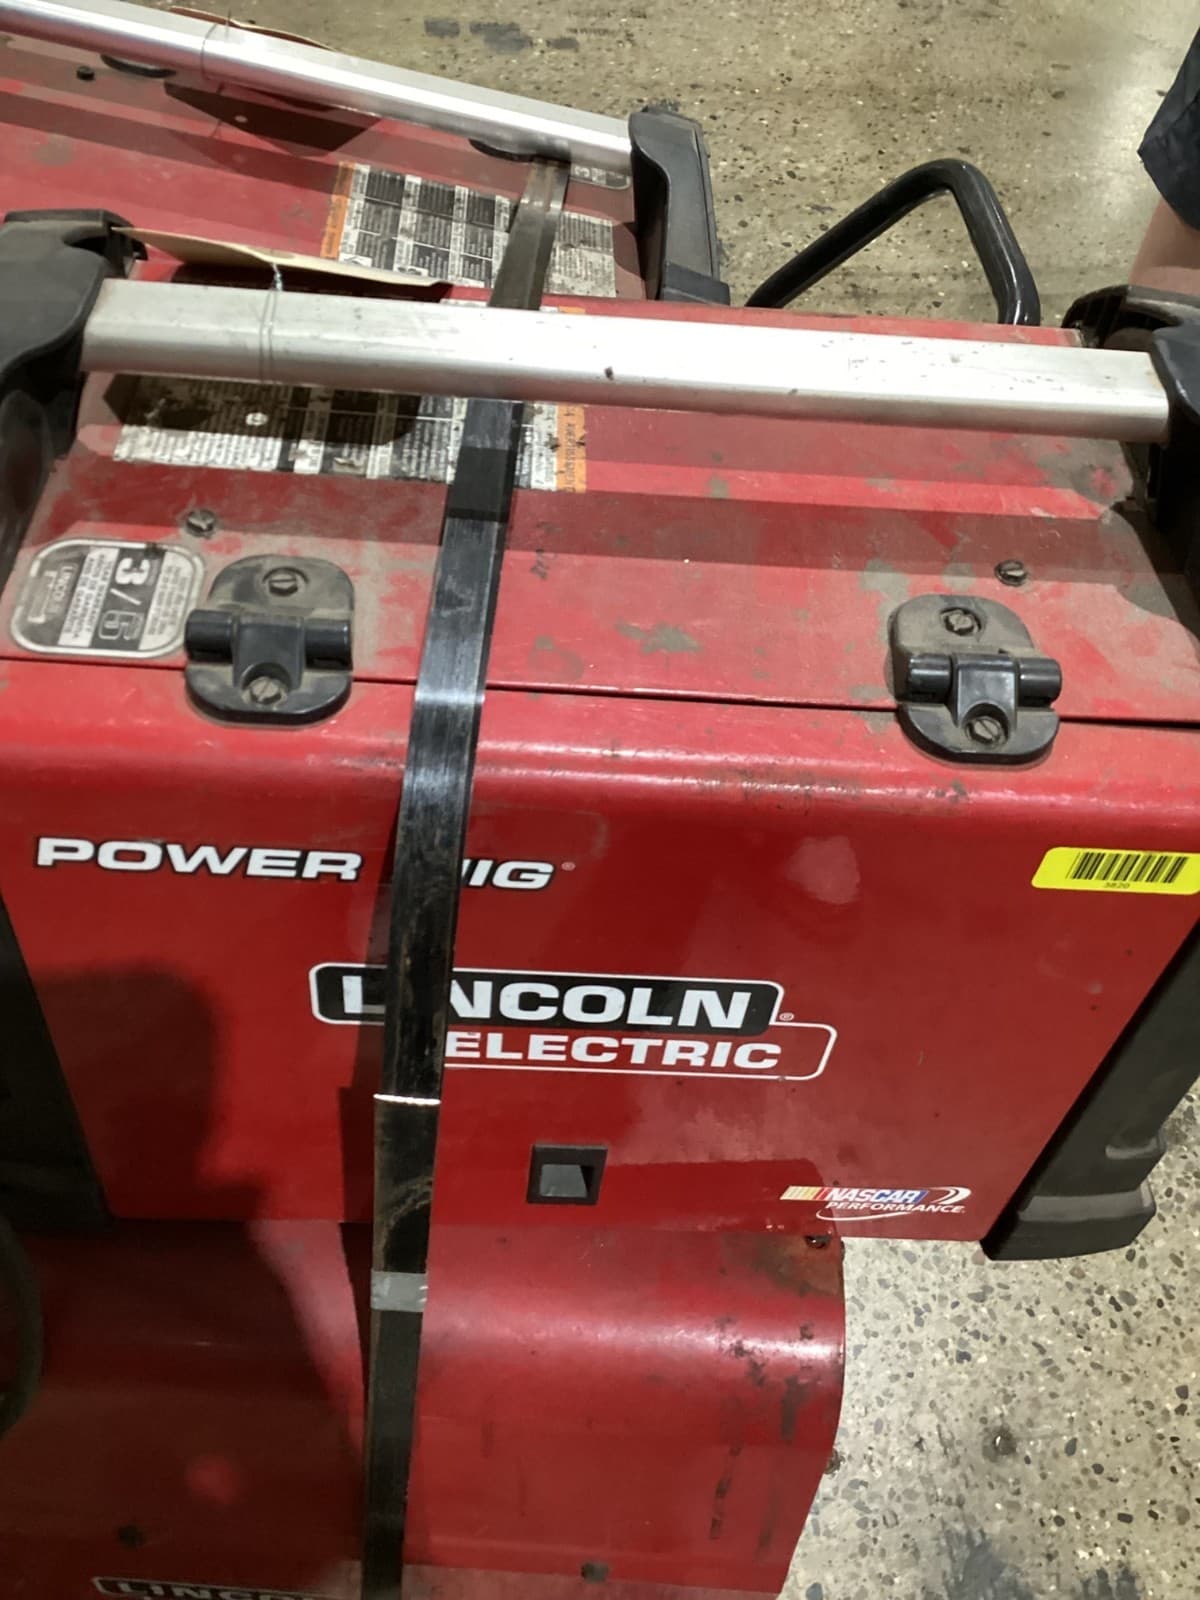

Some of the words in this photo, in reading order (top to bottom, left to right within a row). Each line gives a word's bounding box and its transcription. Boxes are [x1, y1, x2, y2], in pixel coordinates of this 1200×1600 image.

[37, 837, 363, 880] POWER
[342, 975, 752, 1029] LNCOLN
[445, 1030, 782, 1069] ELECTRIC
[825, 1201, 965, 1214] PERFORMANCE
[826, 1187, 917, 1203] NASCAR
